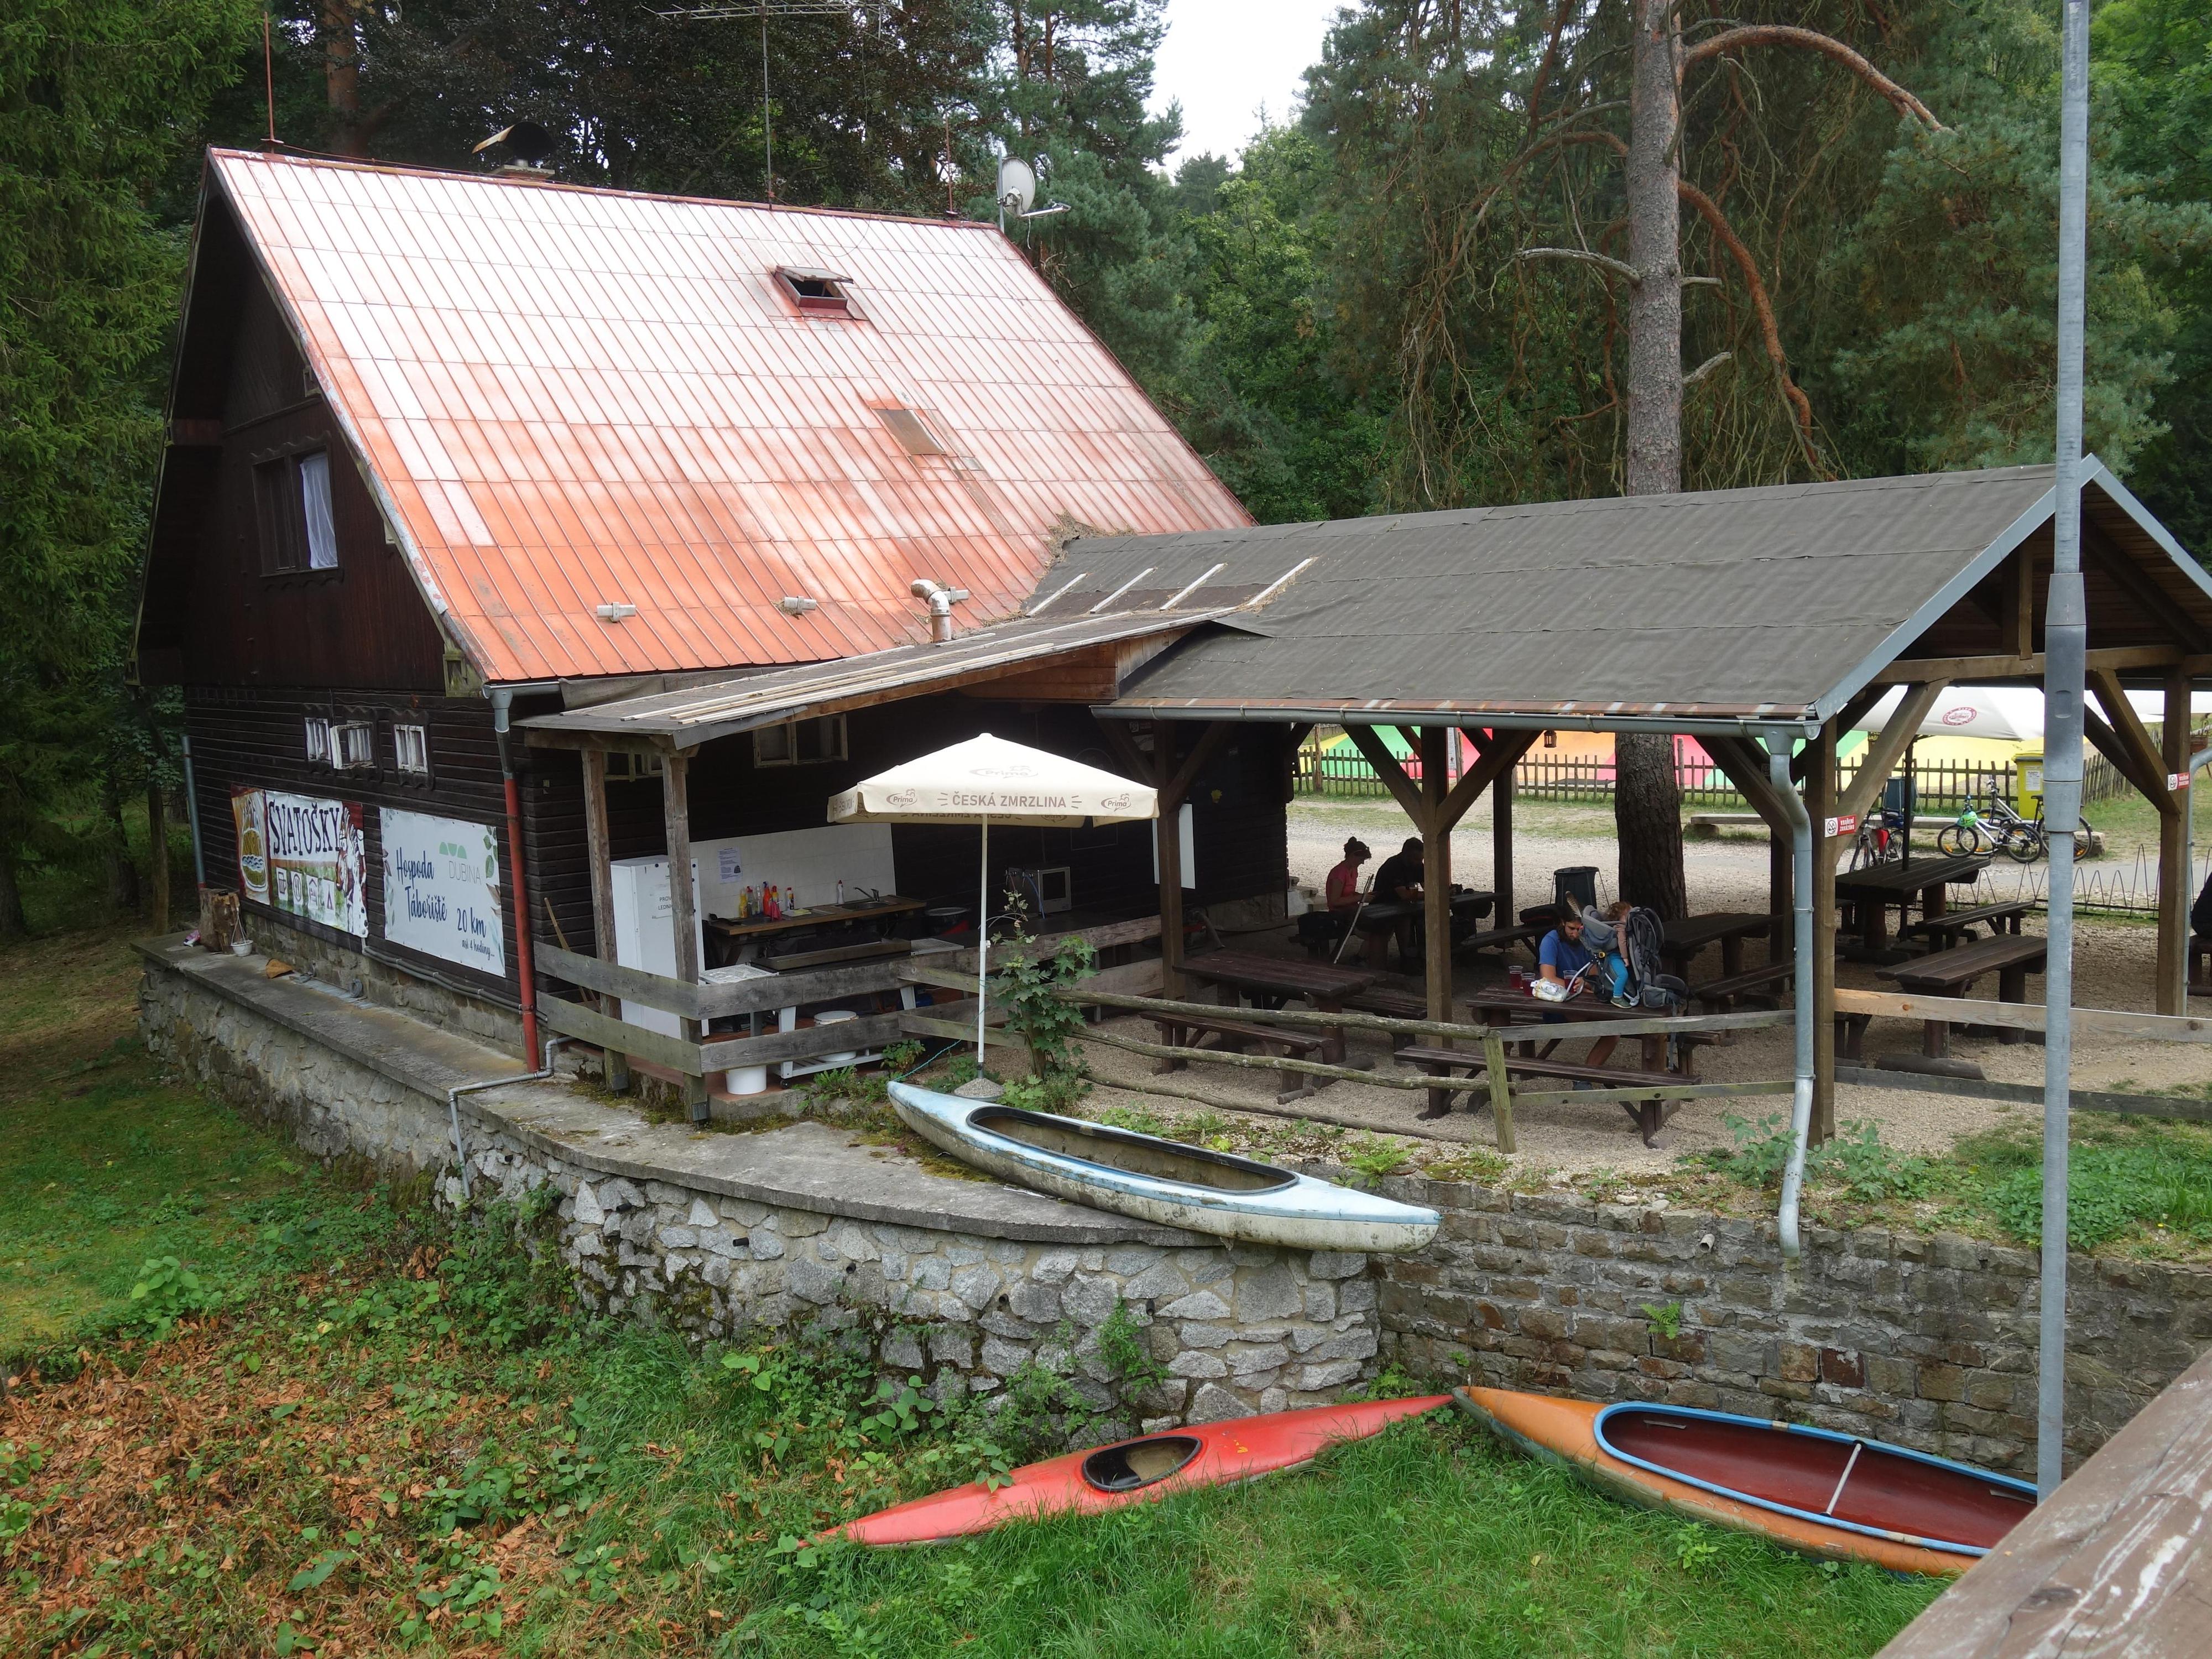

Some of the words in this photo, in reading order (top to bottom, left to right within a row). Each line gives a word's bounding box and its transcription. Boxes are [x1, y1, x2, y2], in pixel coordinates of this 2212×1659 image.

[952, 791, 996, 806] ČESKÁ
[1000, 795, 1067, 808] ZMRZLINA
[396, 847, 435, 890] Hospoda
[448, 860, 482, 885] DUBINA
[405, 886, 447, 922] Tábořiště
[457, 908, 467, 933] 20
[471, 907, 487, 938] km
[470, 940, 473, 951] 4
